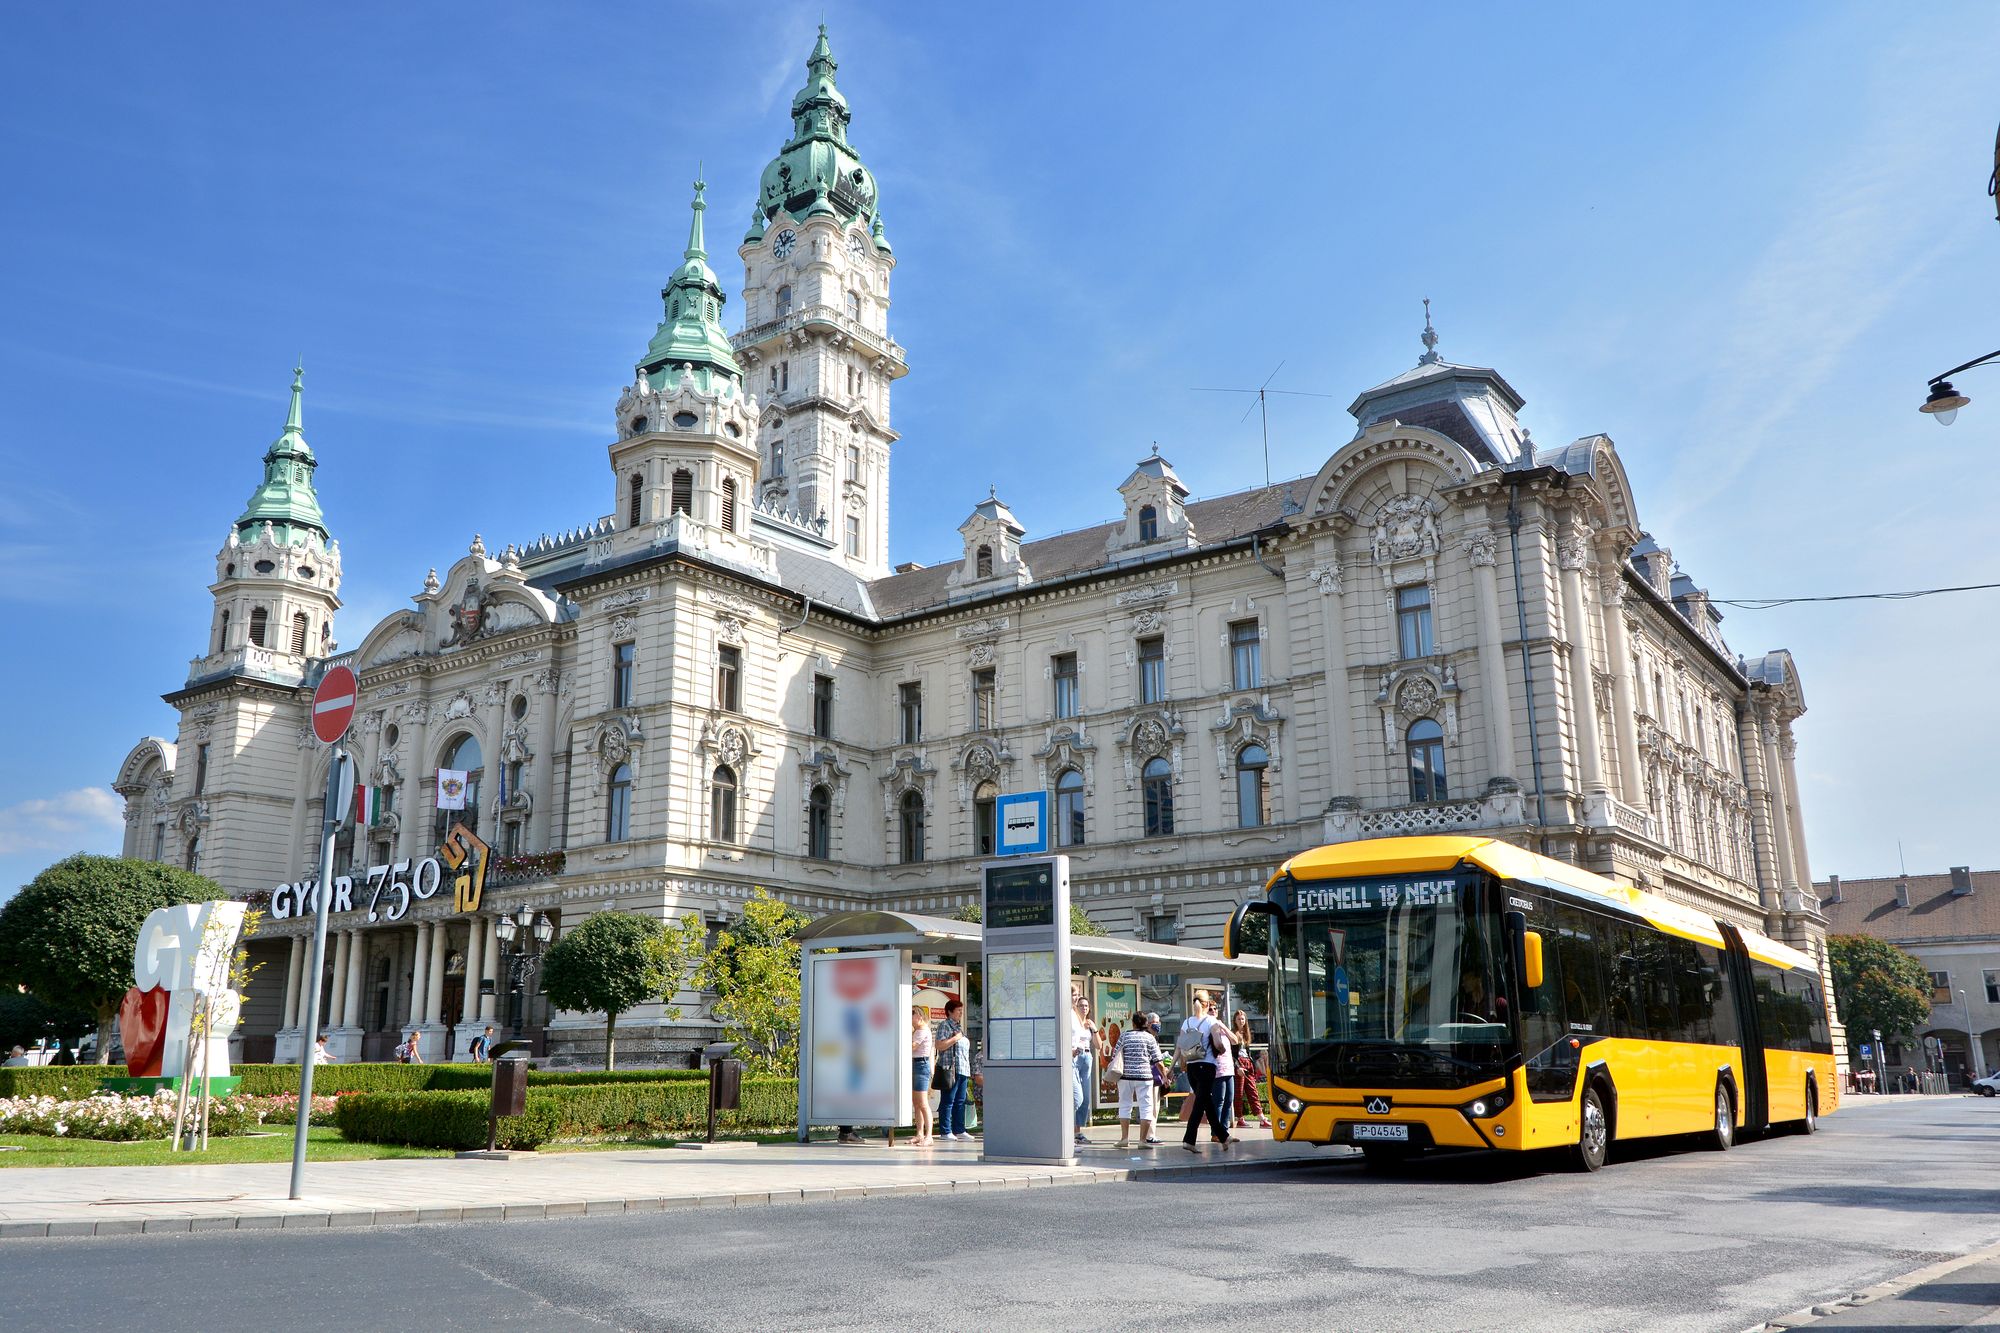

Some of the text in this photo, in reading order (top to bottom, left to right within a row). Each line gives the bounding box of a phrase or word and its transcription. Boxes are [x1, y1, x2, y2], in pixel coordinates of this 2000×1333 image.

[366, 857, 441, 923] 750
[1297, 880, 1456, 912] ECONELL 18 NEXT
